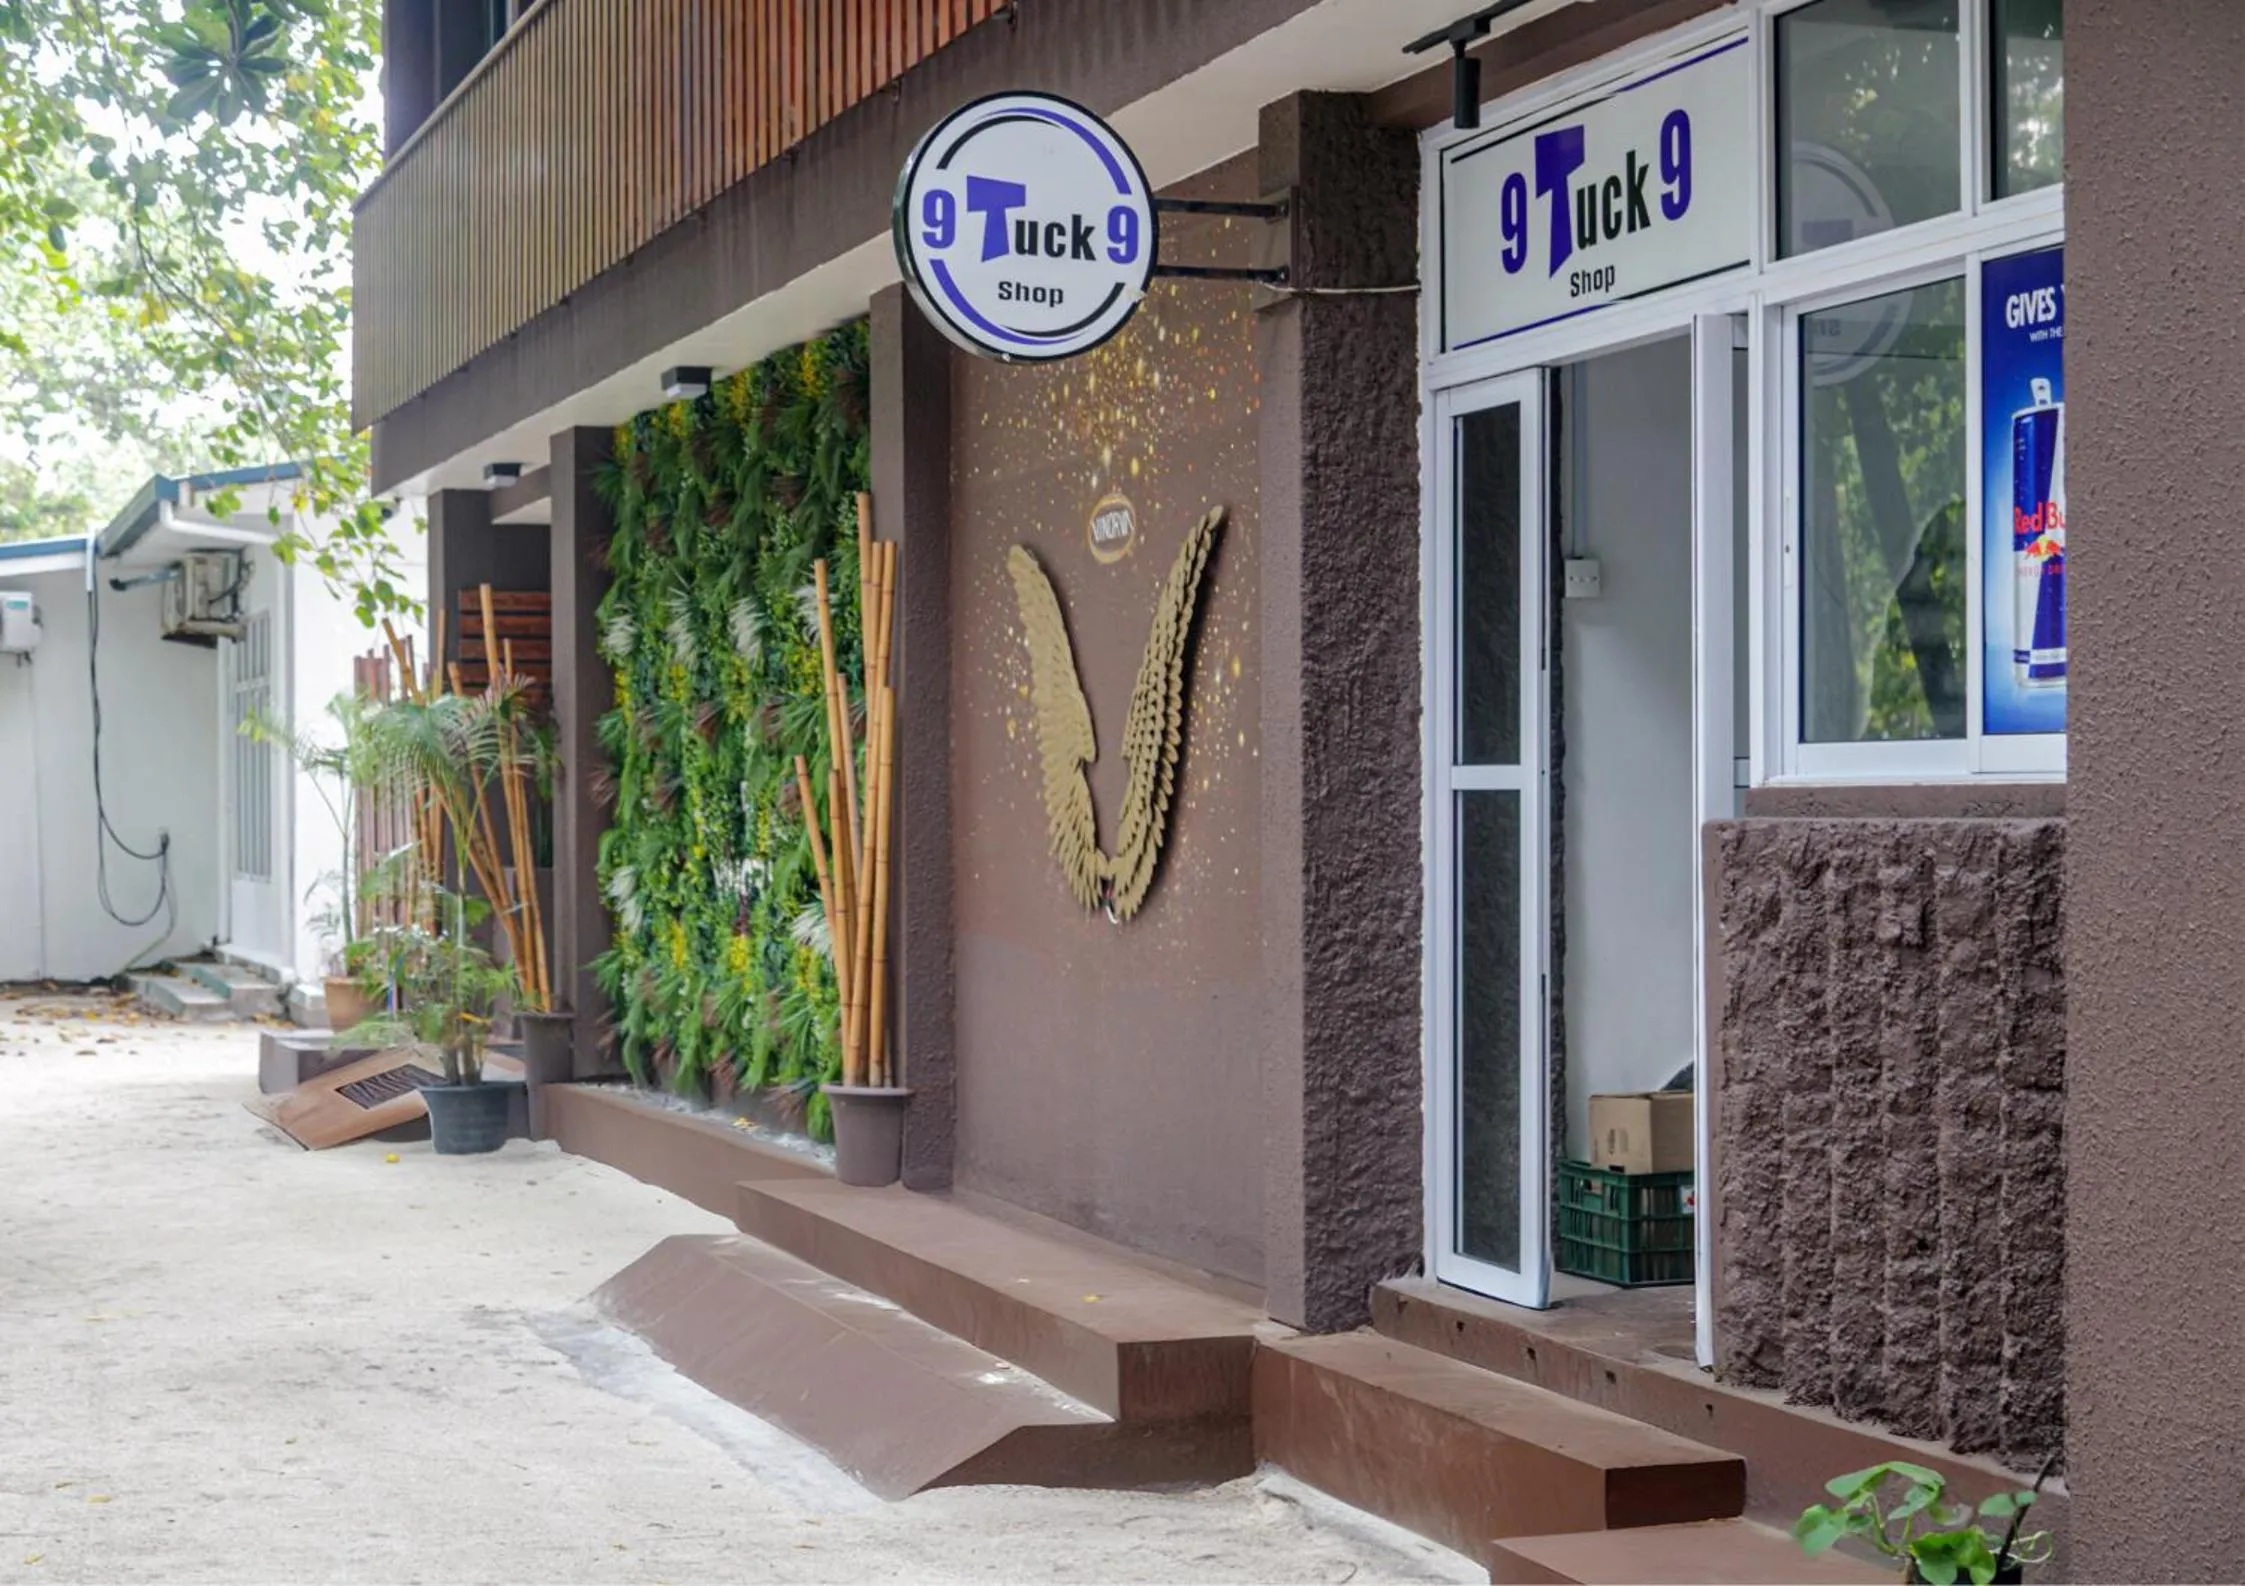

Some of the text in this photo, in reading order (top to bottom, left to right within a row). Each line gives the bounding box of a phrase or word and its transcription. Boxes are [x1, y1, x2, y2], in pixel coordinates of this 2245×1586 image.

[1501, 109, 1692, 279] 9 Tuck 9
[922, 175, 1140, 265] 9 Tuck 9
[998, 280, 1064, 308] Shop
[1570, 265, 1615, 298] Shop
[2005, 286, 2057, 329] GIVES
[2014, 501, 2043, 535] Red
